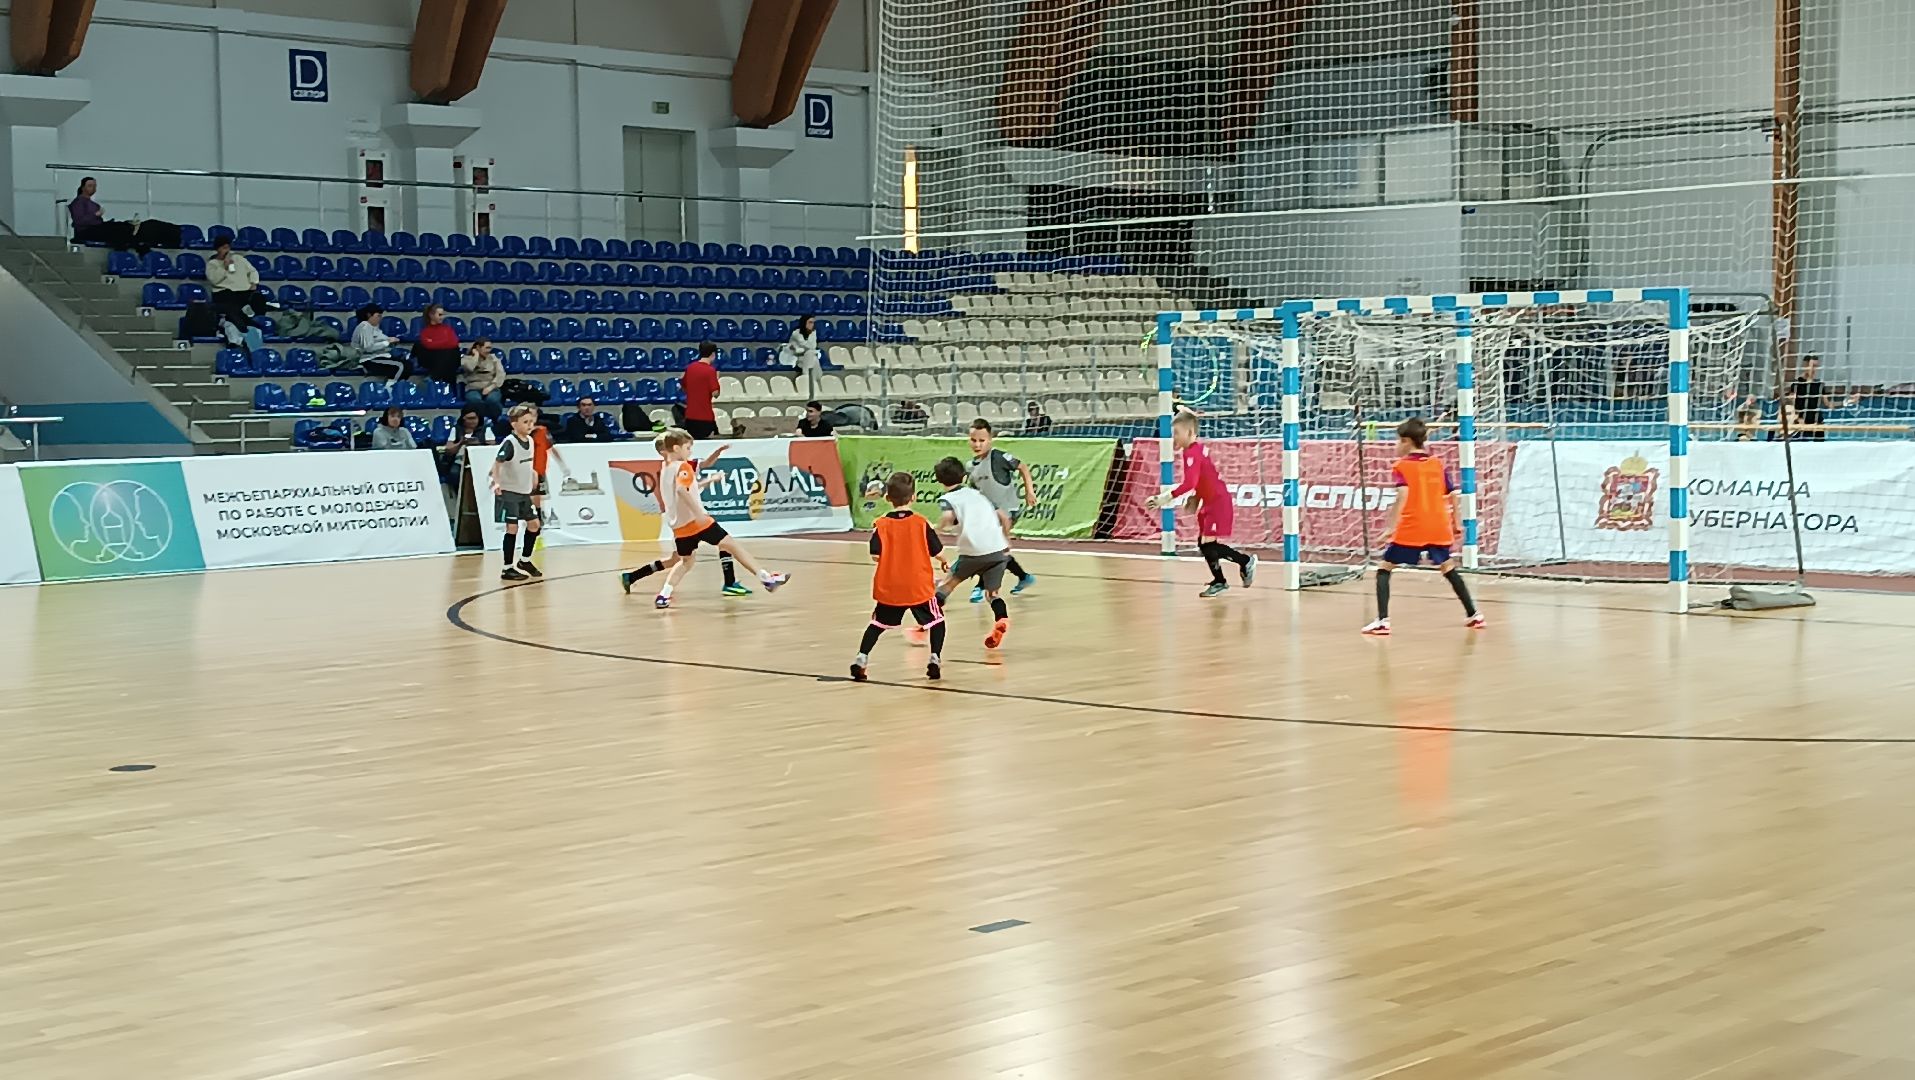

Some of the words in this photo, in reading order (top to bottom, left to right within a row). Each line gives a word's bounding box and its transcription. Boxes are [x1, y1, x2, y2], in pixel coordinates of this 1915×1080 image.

[296, 55, 323, 88] D
[810, 98, 829, 126] D
[203, 482, 375, 503] МЕЖЪЕПАРХИАЛЬНЫЙ
[378, 480, 425, 494] ОТДЕЛ
[632, 466, 827, 498] ФТИВАЛЬ
[1685, 478, 1810, 500] КОМАНДА
[219, 509, 241, 521] ПО
[246, 505, 304, 519] РАБОТЕ
[307, 504, 318, 516] С
[321, 498, 419, 514] МОЛОДЕЖЬЮ
[1689, 509, 1859, 533] УБЕРНАОРА
[216, 520, 324, 539] МОСКОВСКОЙ
[327, 515, 430, 532] МИТРОПОЛИИ
